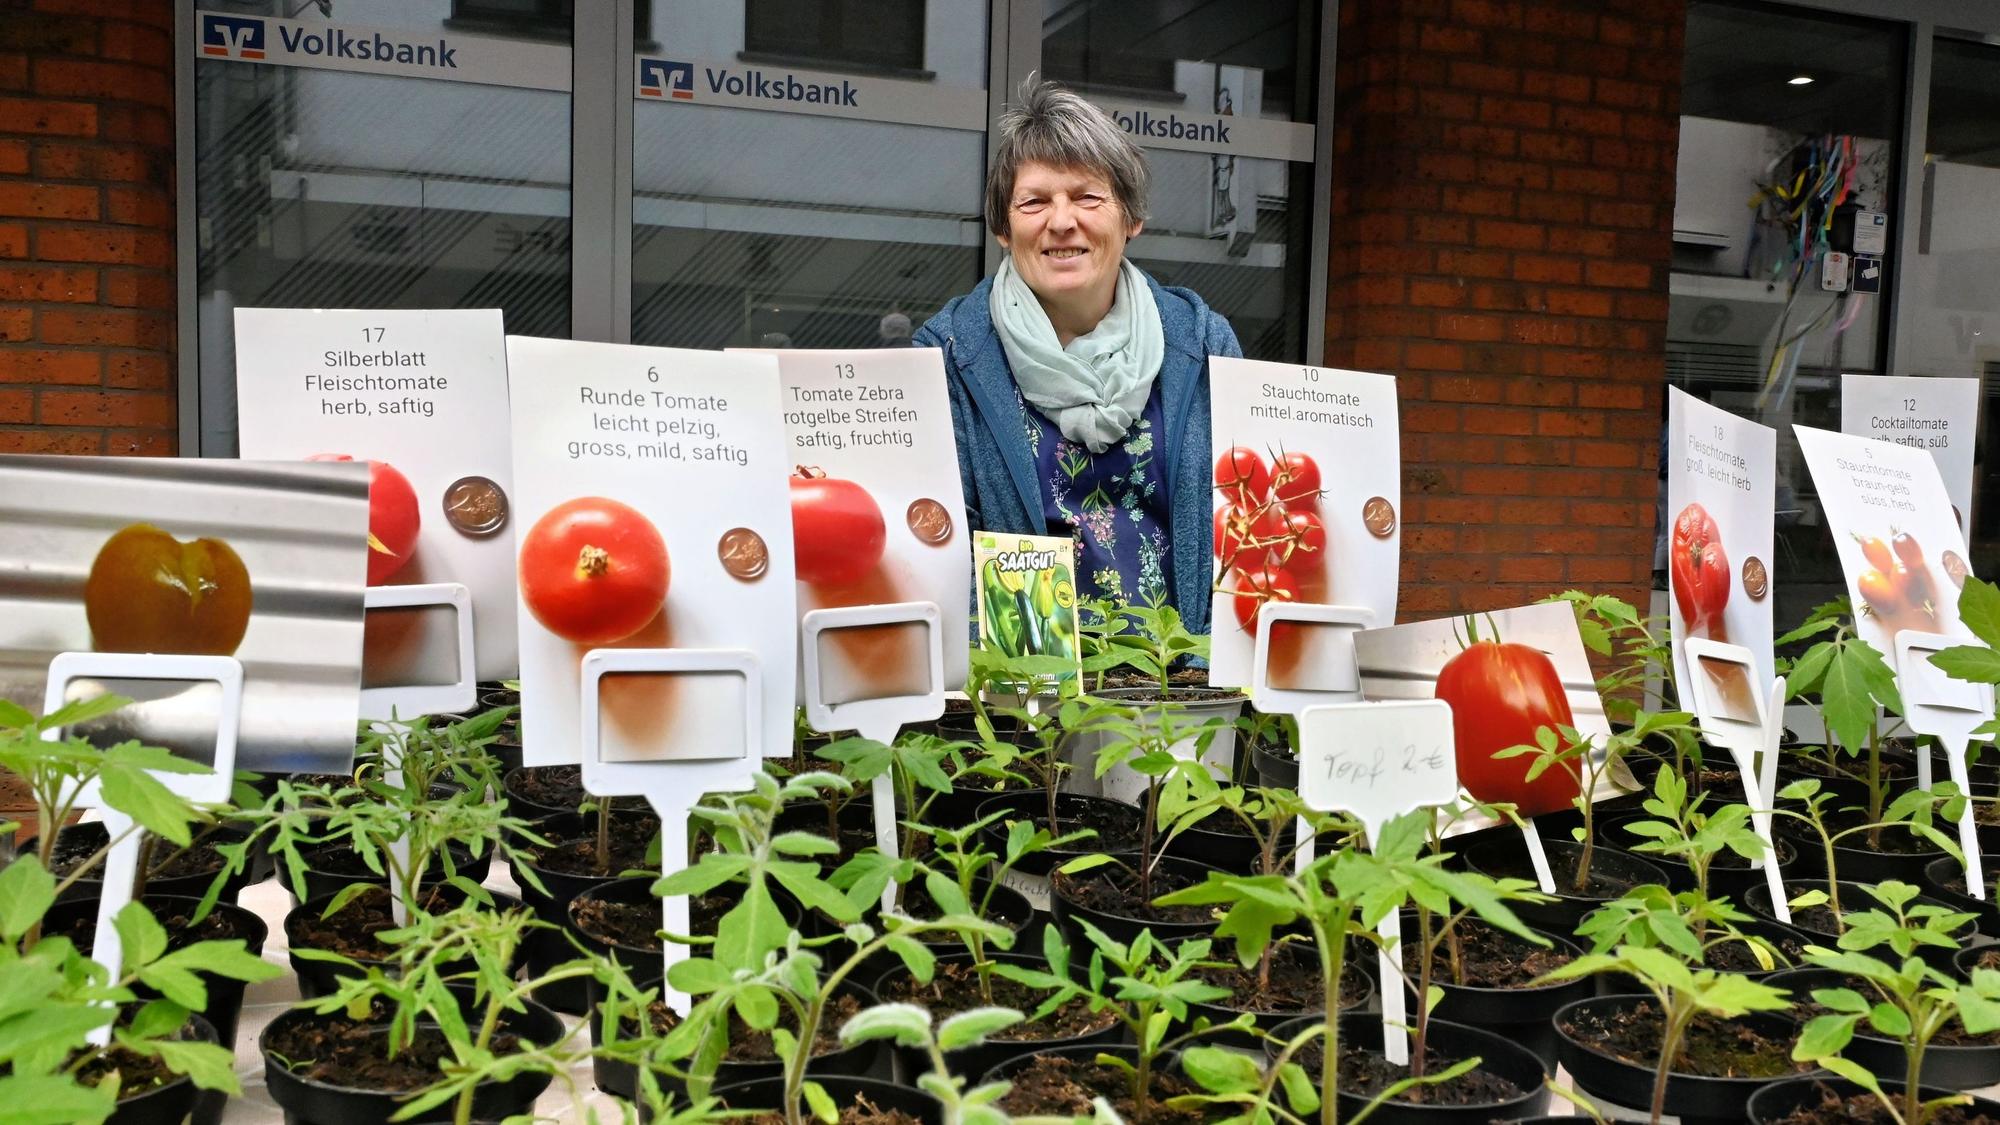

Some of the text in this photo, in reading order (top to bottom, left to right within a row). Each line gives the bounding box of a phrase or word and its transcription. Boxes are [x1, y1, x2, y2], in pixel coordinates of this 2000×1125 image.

[279, 25, 457, 68] Volksbank
[705, 68, 858, 107] Volksbank
[361, 327, 386, 343] 17
[324, 350, 426, 367] Silberblatt
[647, 366, 659, 383] 6
[835, 363, 855, 379] 13
[1302, 368, 1319, 382] 10
[305, 374, 447, 391] Fleischtomate
[790, 385, 904, 401] Tomate Zebra
[580, 386, 728, 411] Runde Tomate
[1262, 383, 1360, 407] Stauchtomate
[1904, 398, 1916, 411] 12
[321, 396, 434, 417] herb, saftig
[784, 406, 918, 428] rotgelbe Streifen
[593, 412, 720, 439] leicht pelzig,
[1713, 425, 1724, 441] 18
[1871, 416, 1948, 430] Cocktailtomate
[796, 429, 913, 450] saftig, fruchtig
[1929, 435, 1948, 448] süß
[568, 440, 748, 466] gross, mild, saftig
[1688, 434, 1747, 472] Fleischtomate,
[1864, 447, 1873, 459] 5
[1707, 463, 1730, 485] leicht
[1732, 472, 1751, 491] herb
[1836, 458, 1912, 481] Stauchtomate
[1019, 539, 1034, 552] BIO
[998, 550, 1056, 573] SAATGUT
[1323, 747, 1385, 789] Topf
